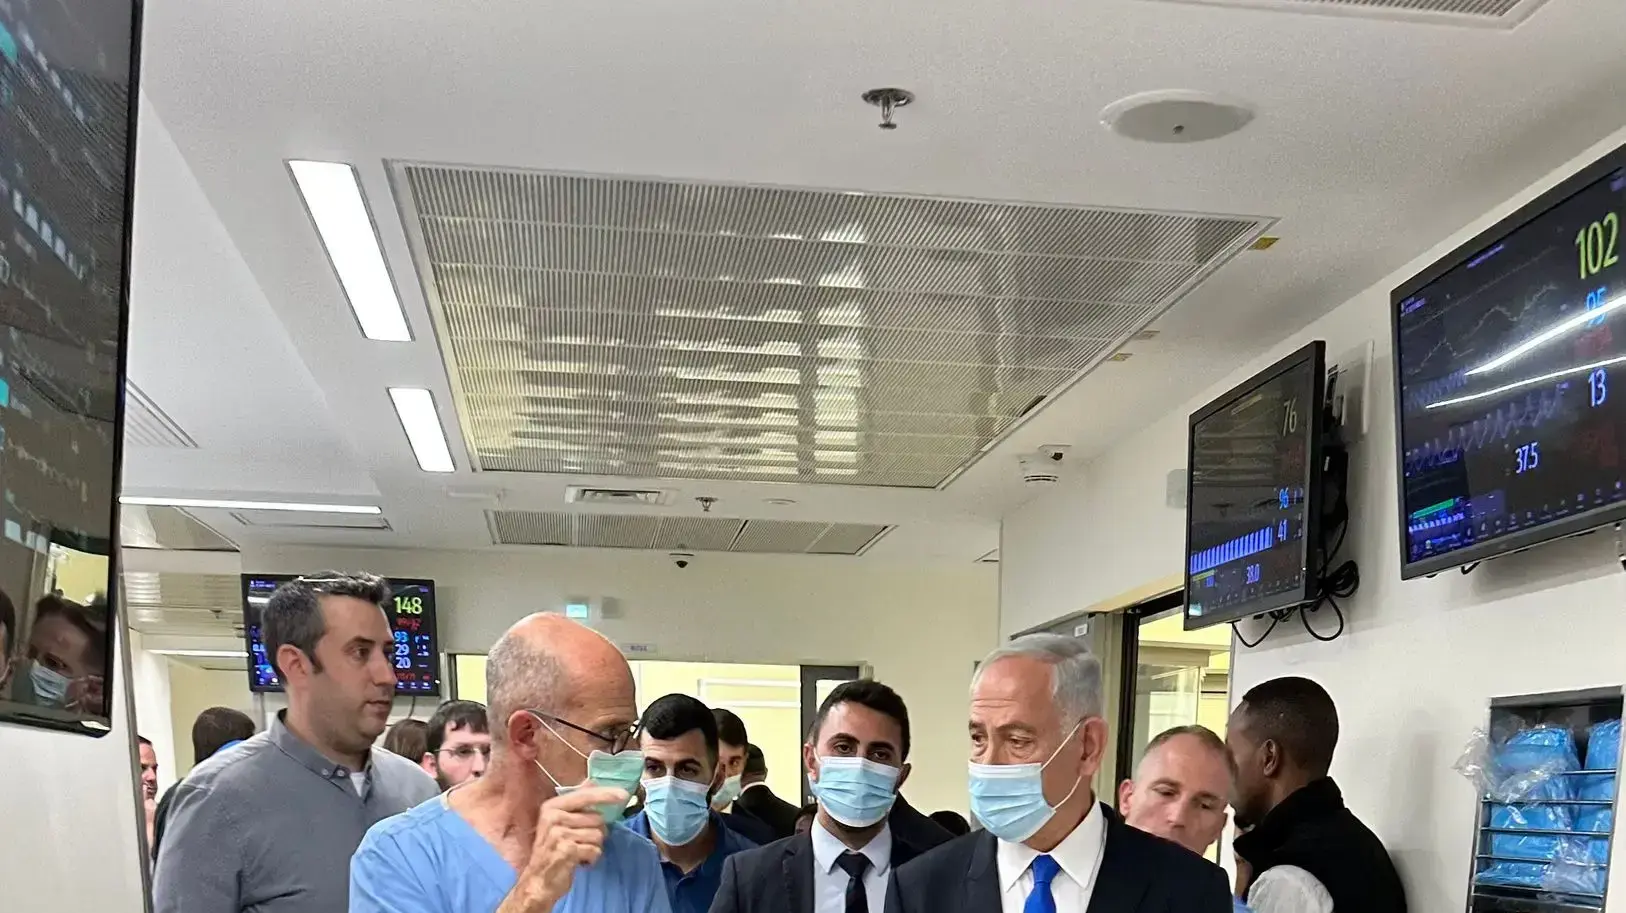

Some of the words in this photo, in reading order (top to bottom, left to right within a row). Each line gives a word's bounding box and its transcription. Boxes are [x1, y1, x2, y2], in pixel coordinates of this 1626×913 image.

[1575, 212, 1619, 279] 102
[1588, 369, 1606, 407] 13
[1283, 397, 1297, 437] 76
[394, 596, 423, 615] 148
[394, 631, 409, 643] 93
[395, 643, 410, 656] 29
[395, 657, 412, 669] 20
